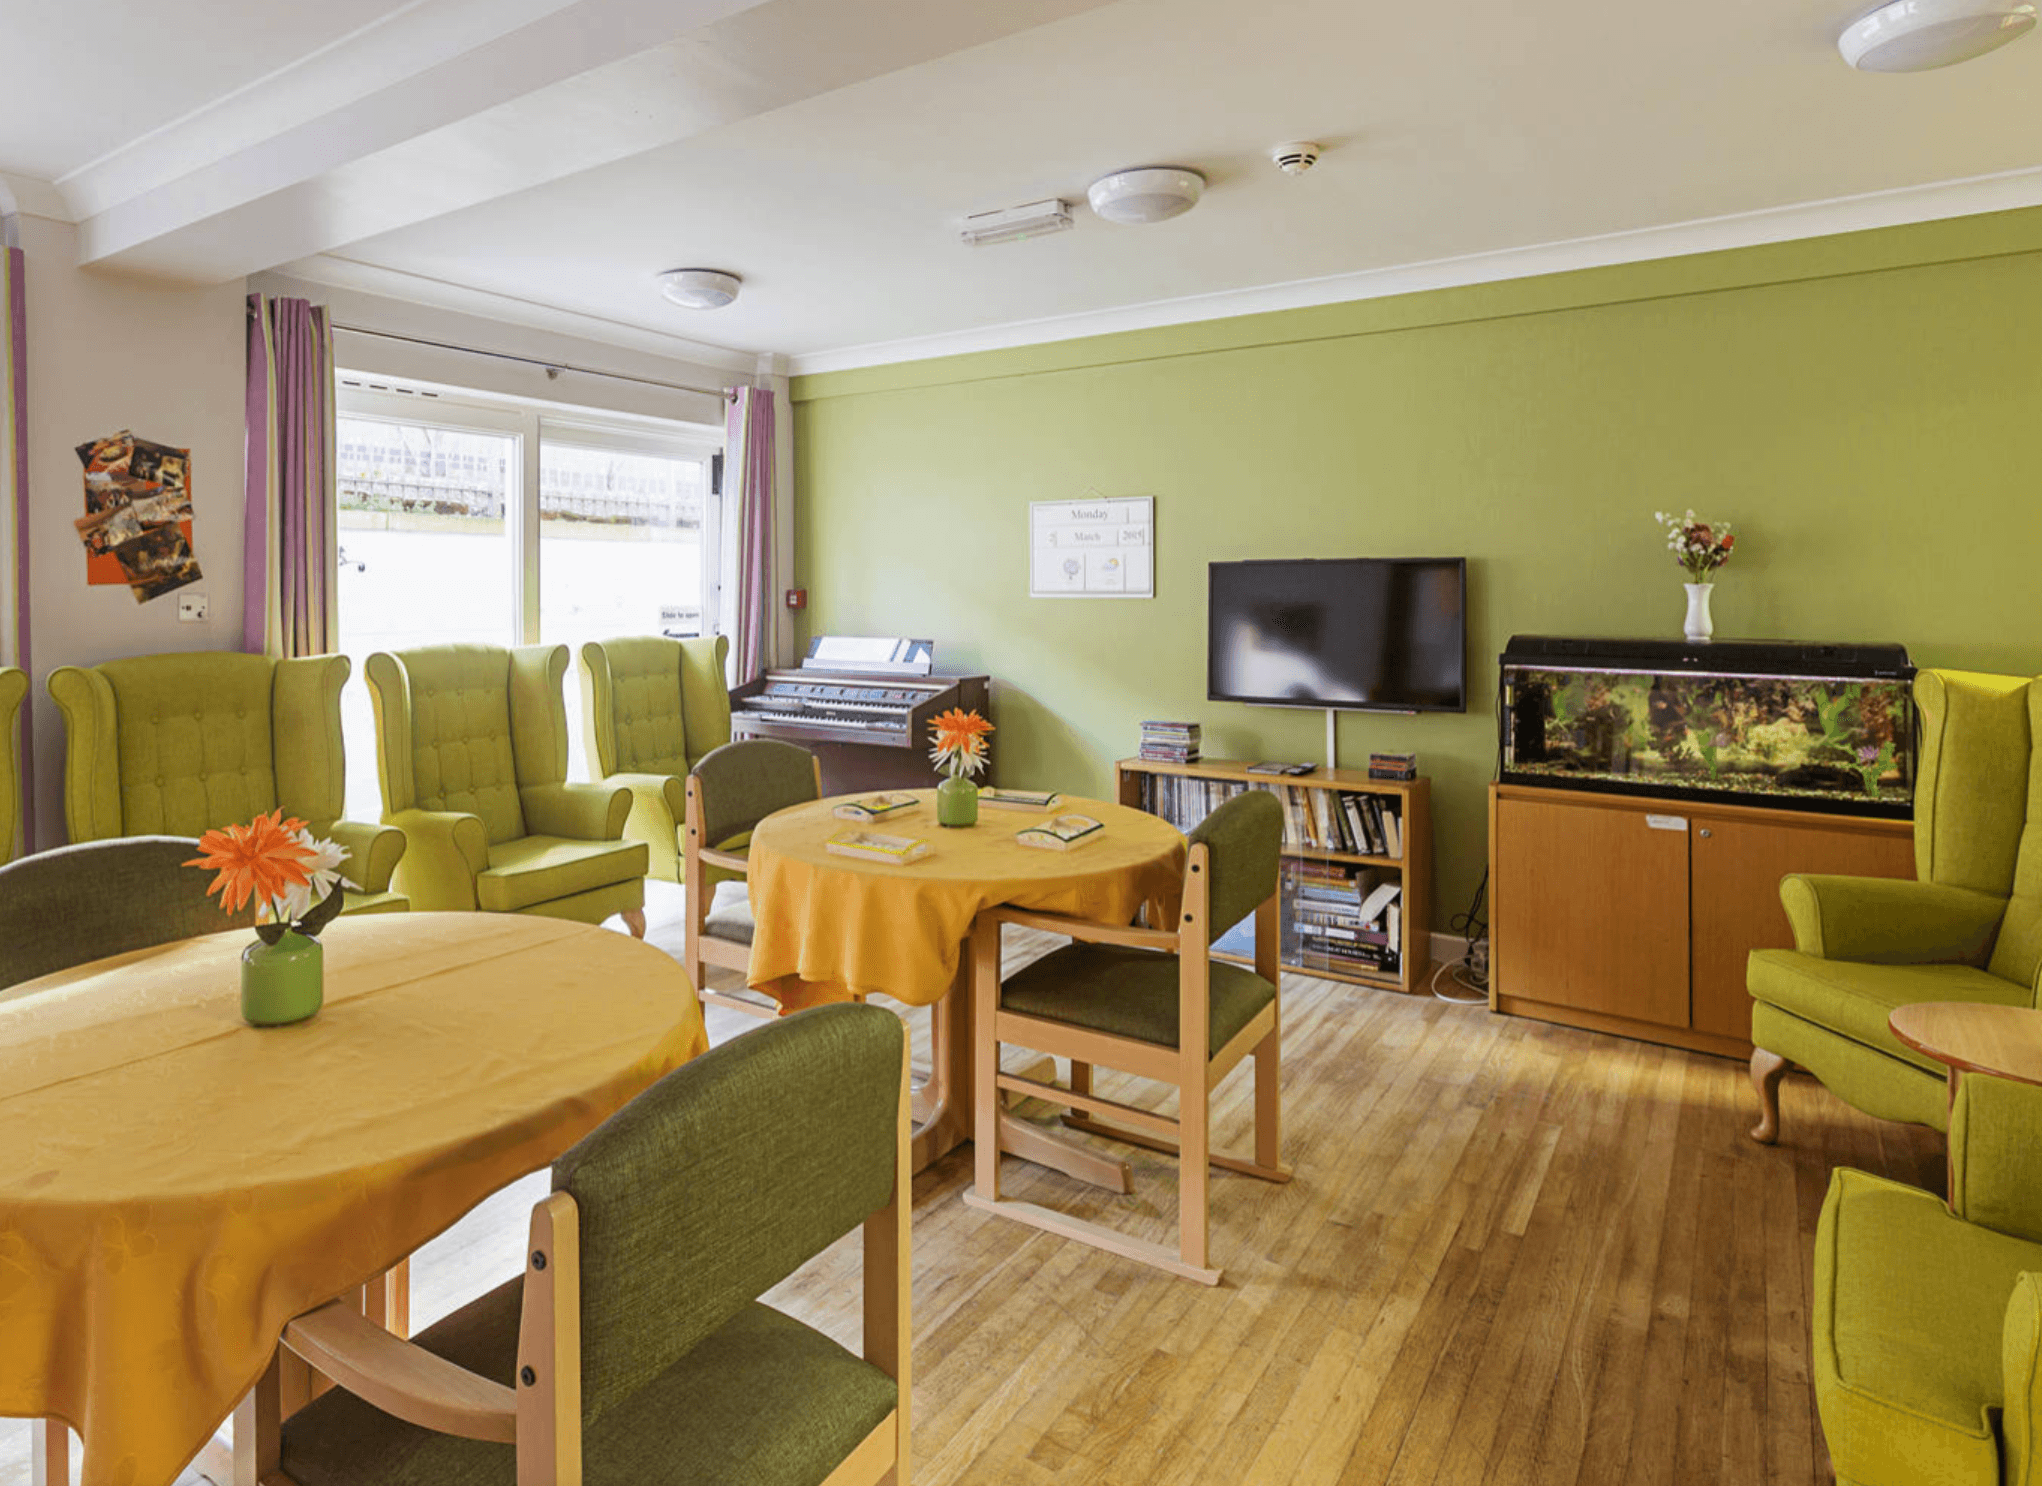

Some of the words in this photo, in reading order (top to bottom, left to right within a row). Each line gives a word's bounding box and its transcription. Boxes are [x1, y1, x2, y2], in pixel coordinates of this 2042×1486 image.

[1071, 508, 1108, 521] Monday
[1074, 531, 1101, 541] March
[678, 611, 684, 619] to
